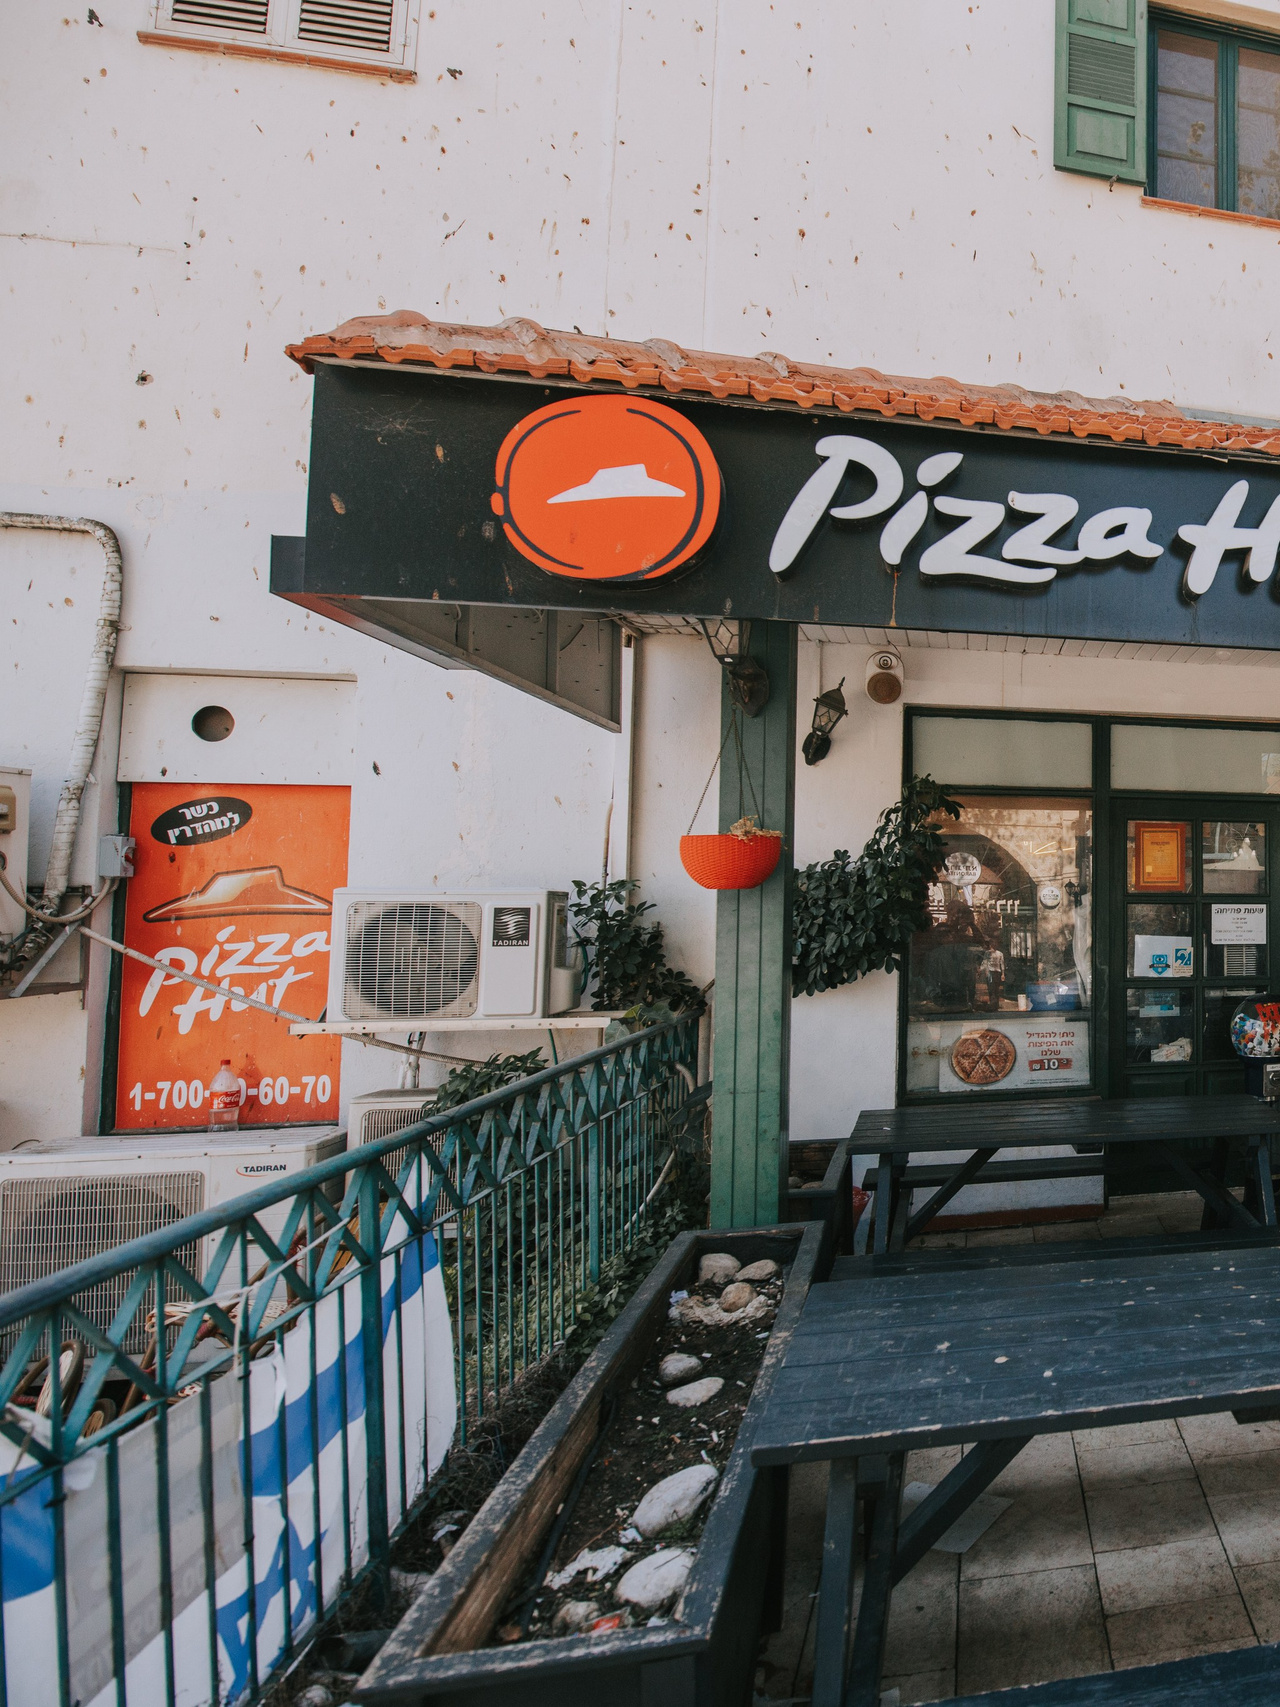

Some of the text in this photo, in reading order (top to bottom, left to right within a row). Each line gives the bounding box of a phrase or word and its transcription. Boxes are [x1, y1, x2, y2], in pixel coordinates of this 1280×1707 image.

[769, 435, 1165, 584] Pizza
[178, 801, 220, 820] כשר
[167, 812, 241, 844] למהדרין
[139, 925, 332, 1017] Pizza
[172, 966, 314, 1035] Hut
[1026, 1031, 1057, 1039] להגדיל
[1027, 1040, 1058, 1048] הפיצות
[1041, 1048, 1061, 1056] שלנו
[129, 1074, 332, 1111] 1-700-0-60-70
[243, 1164, 287, 1173] TADIRAN
